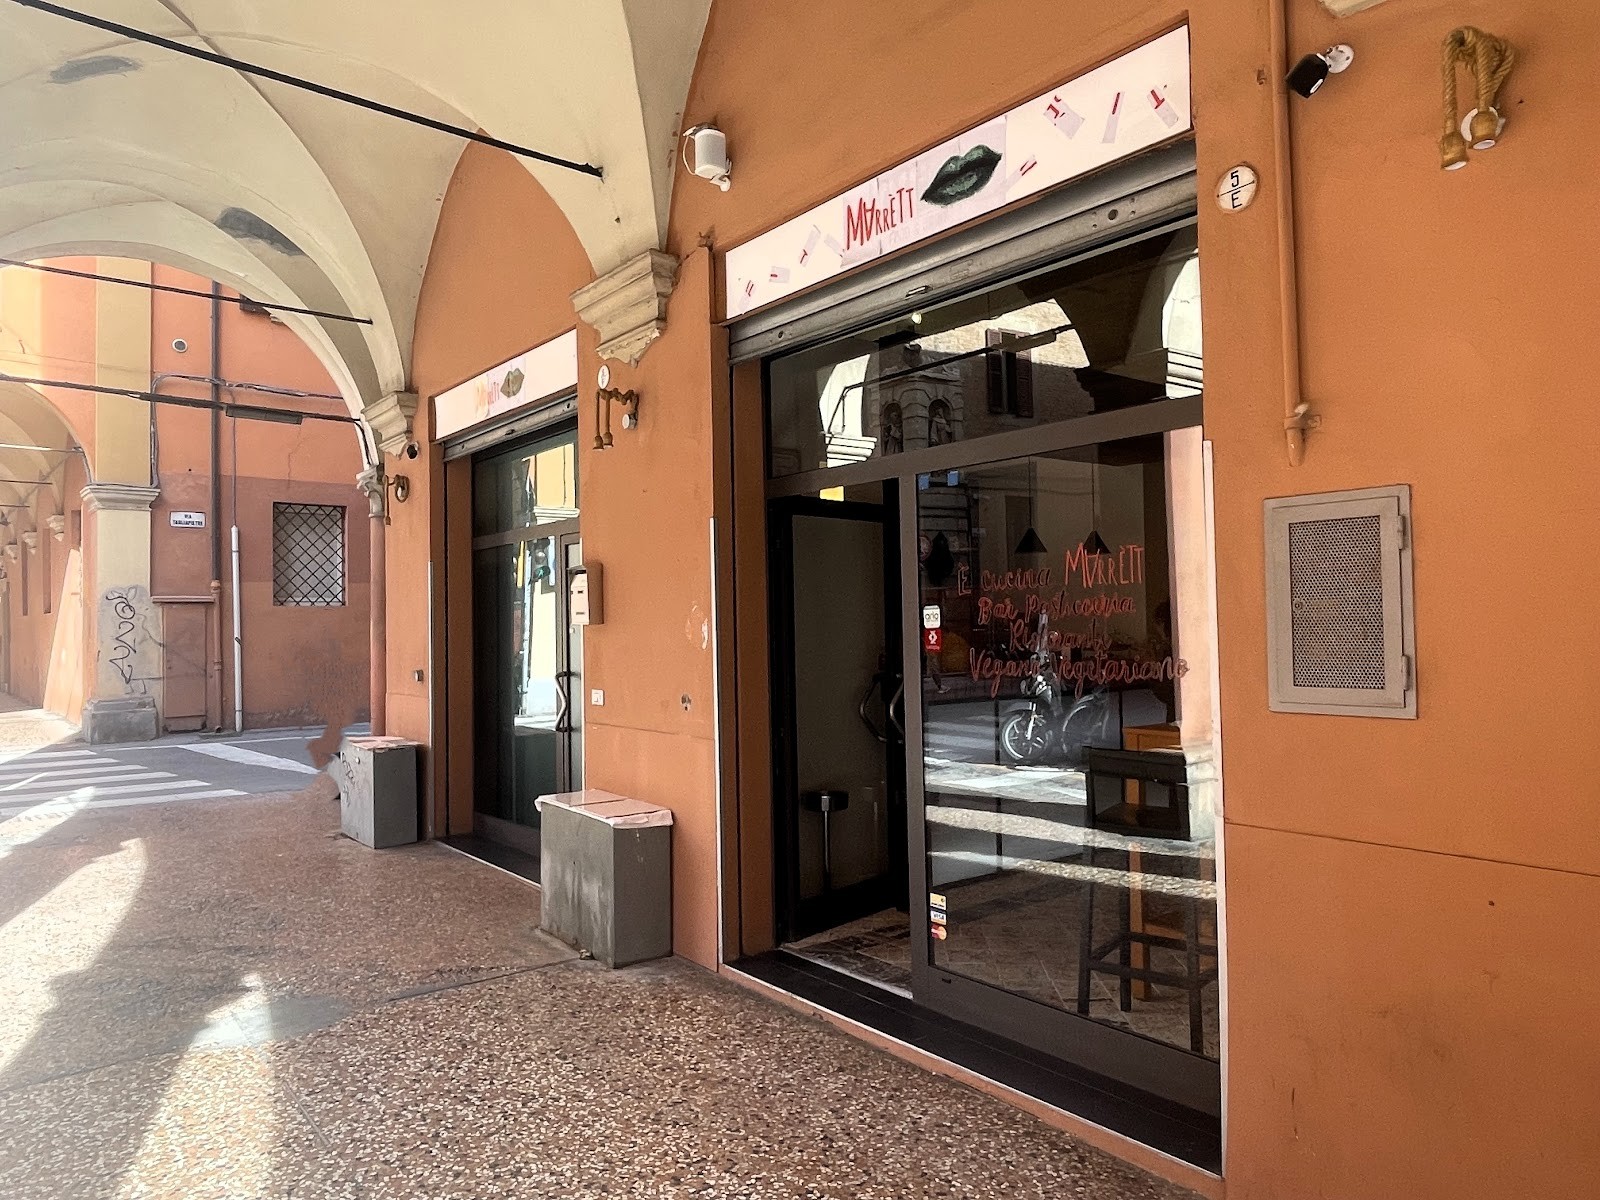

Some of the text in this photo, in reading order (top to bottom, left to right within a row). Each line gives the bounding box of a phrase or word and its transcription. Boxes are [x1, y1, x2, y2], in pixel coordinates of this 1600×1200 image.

[1230, 169, 1240, 188] 5
[1231, 190, 1243, 209] E
[977, 596, 1019, 625] Bar
